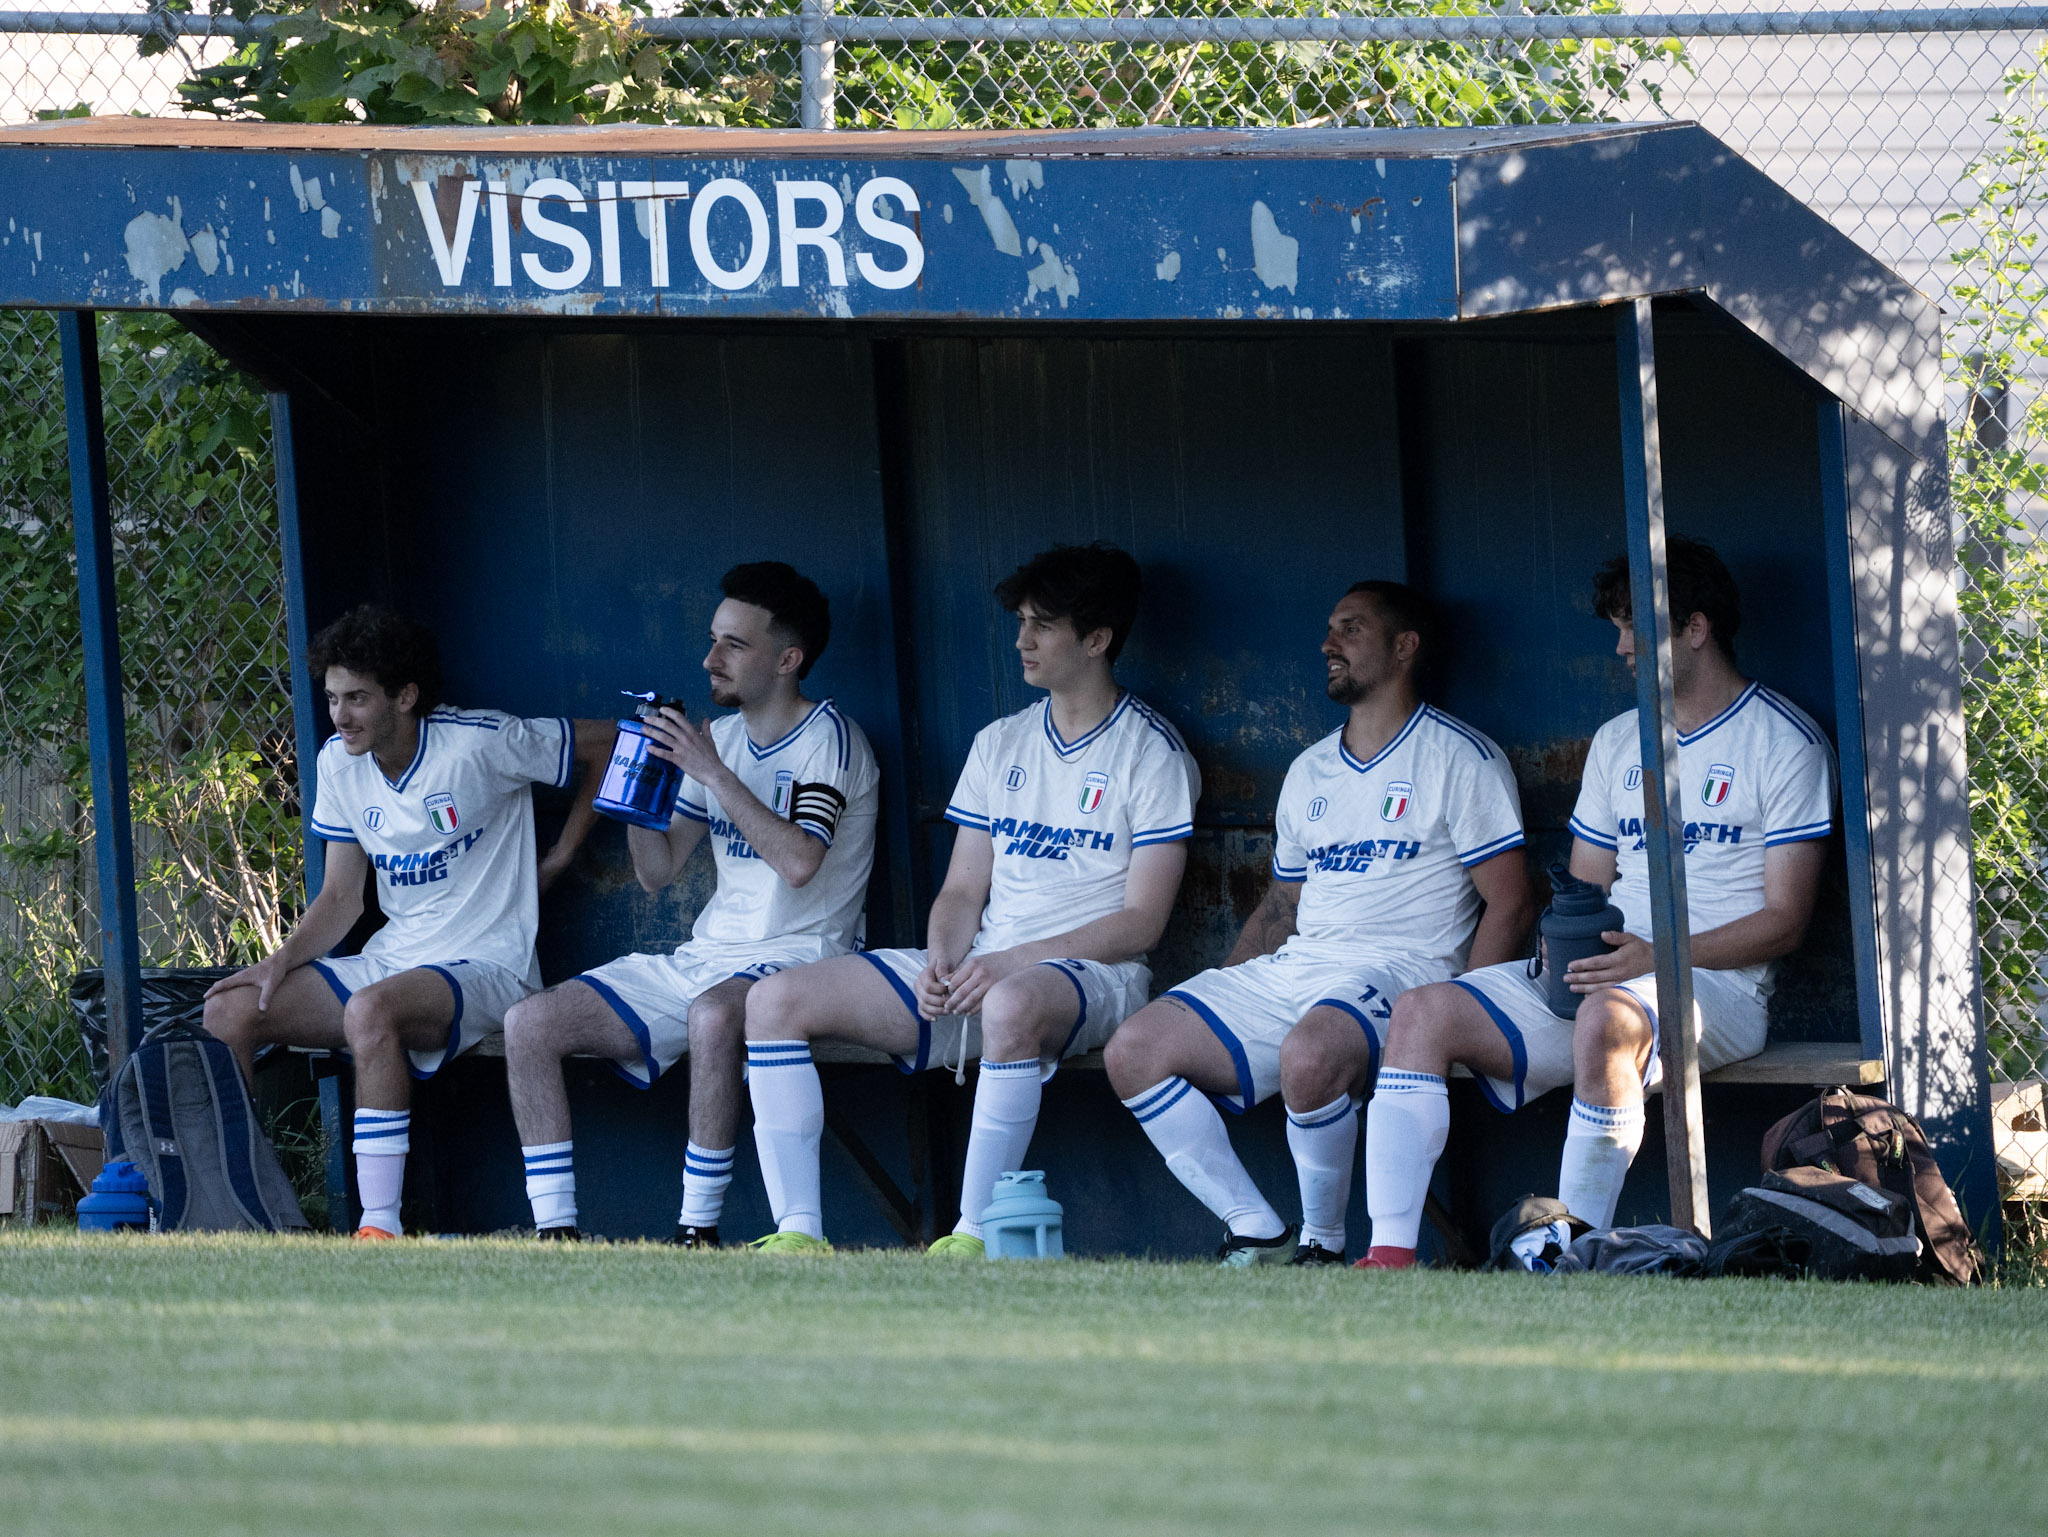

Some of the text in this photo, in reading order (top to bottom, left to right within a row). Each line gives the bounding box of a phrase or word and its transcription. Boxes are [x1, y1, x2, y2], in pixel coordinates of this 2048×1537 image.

[410, 176, 925, 291] VISITORS
[726, 840, 762, 859] MU
[1004, 839, 1070, 861] MUG
[390, 863, 447, 887] MUG
